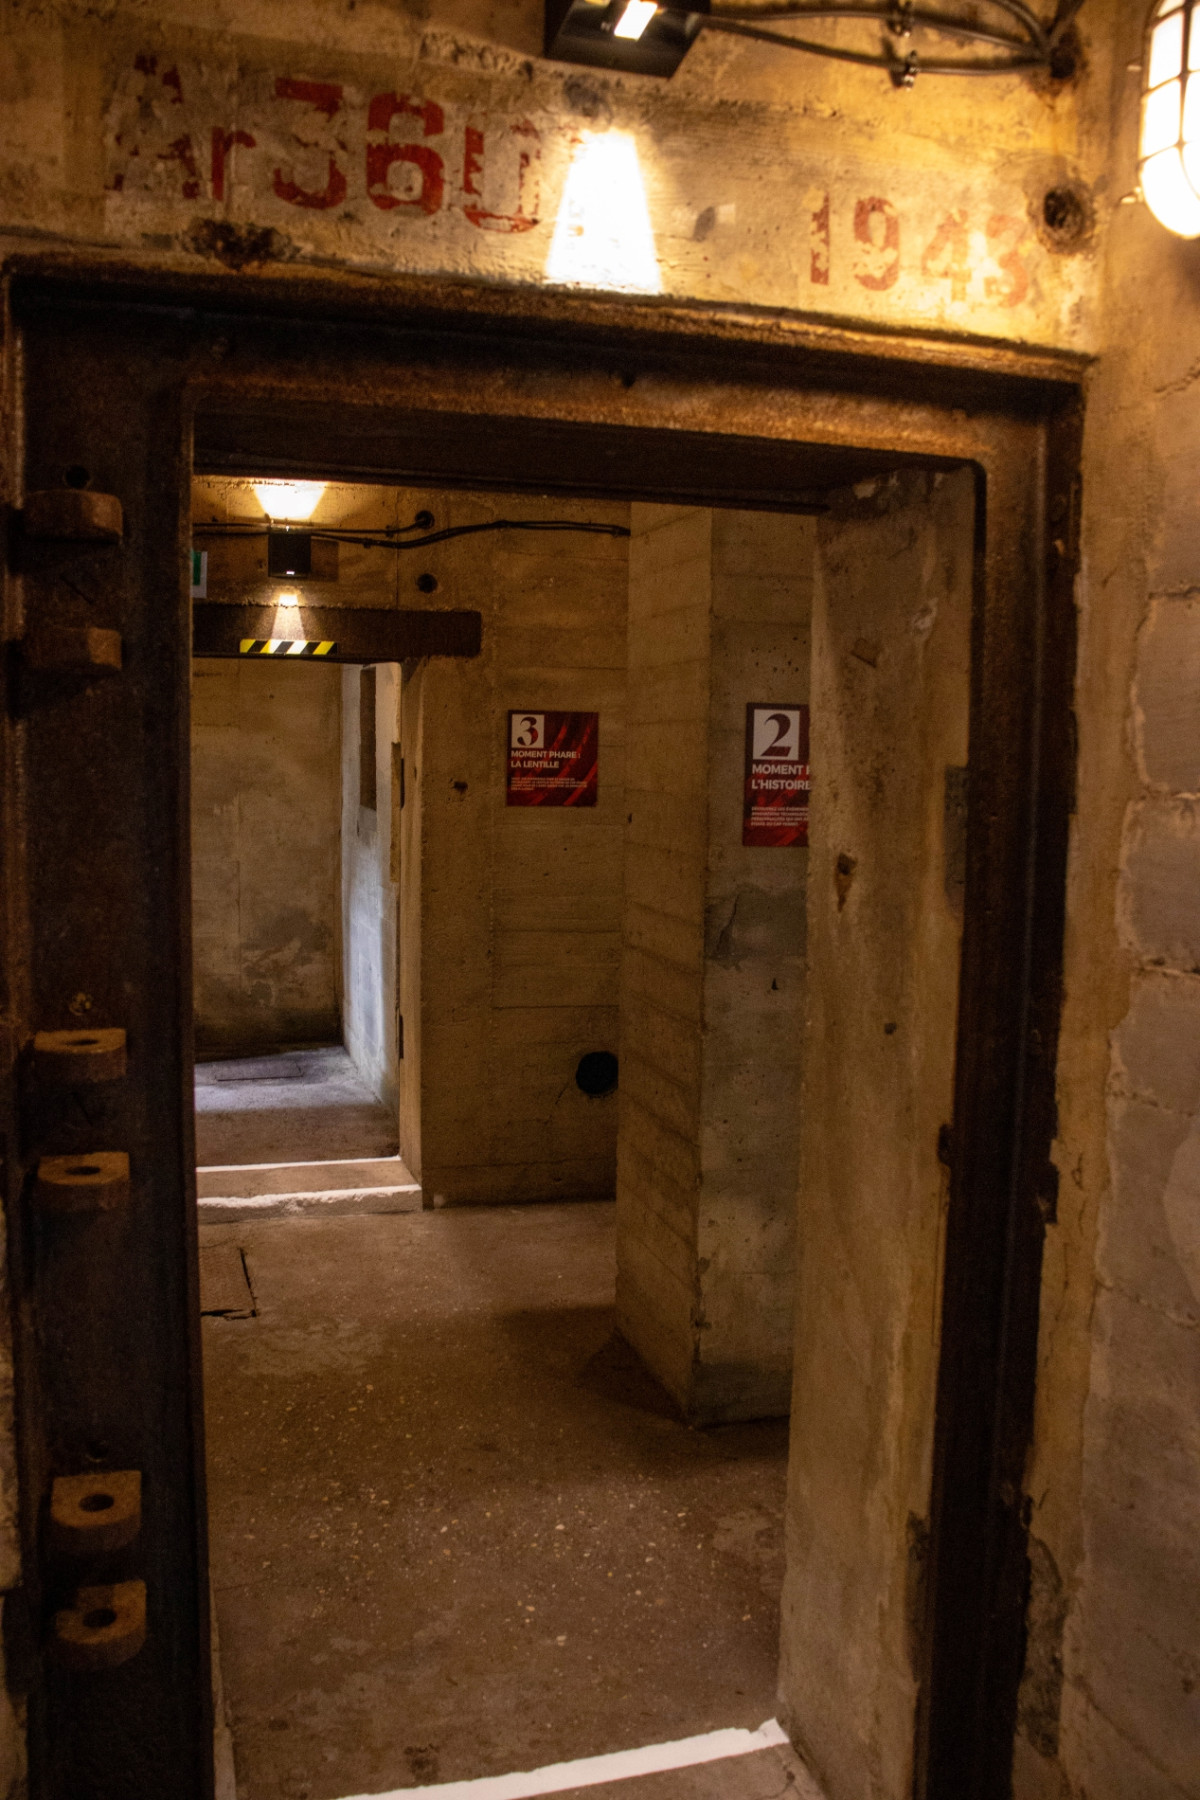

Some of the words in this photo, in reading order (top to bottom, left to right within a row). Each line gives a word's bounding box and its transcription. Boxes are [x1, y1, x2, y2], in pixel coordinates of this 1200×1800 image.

[809, 191, 1030, 309] 1943
[516, 716, 539, 746] 3
[760, 713, 792, 757] 2
[511, 750, 547, 758] MOMENT
[511, 760, 521, 768] LA
[523, 760, 560, 769] LENTILLE
[752, 764, 803, 775] MOMENT
